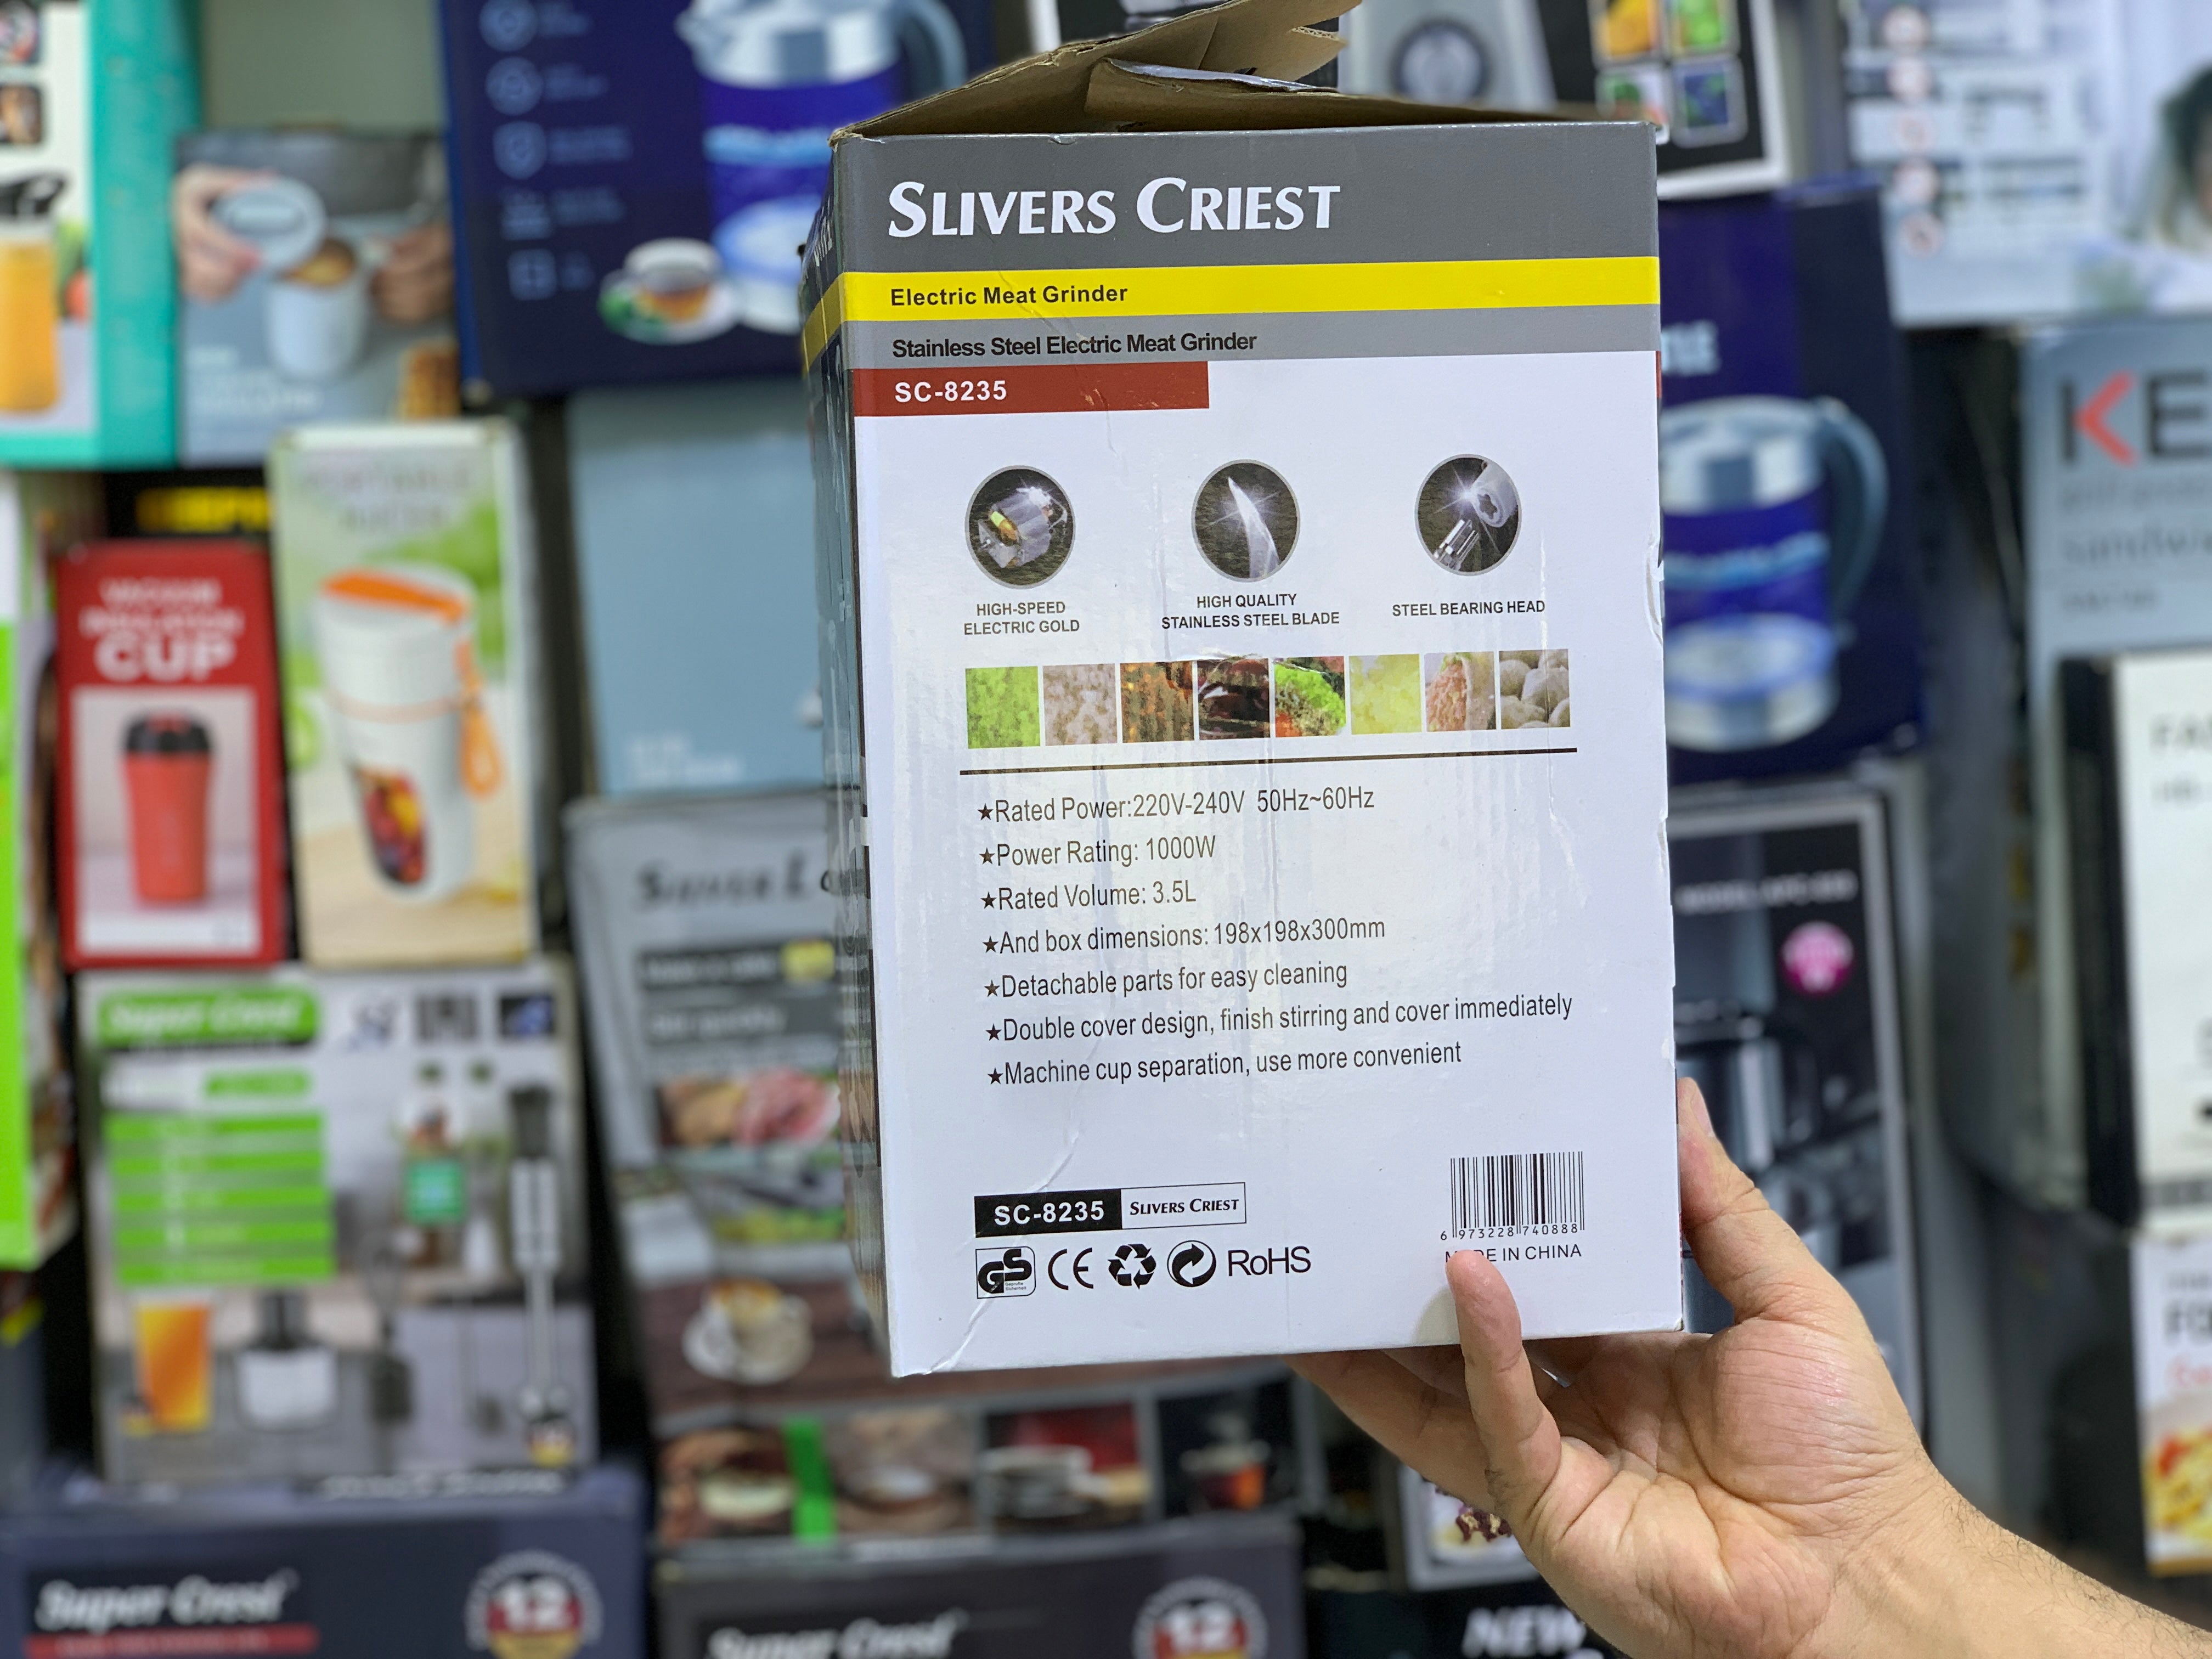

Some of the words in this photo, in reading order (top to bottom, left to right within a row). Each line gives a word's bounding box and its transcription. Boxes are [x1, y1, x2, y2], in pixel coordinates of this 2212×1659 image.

[888, 181, 1116, 238] SLIVERS
[1137, 177, 1340, 233] CRIEST
[890, 287, 977, 306] Electric
[984, 286, 1036, 304] Meat
[1043, 285, 1127, 303] Grinder
[893, 338, 985, 358] Stainless
[991, 337, 1041, 356] Steel
[1047, 335, 1121, 354] Electric
[1127, 334, 1176, 352] Meat
[1181, 332, 1257, 351] Grinder
[895, 380, 1007, 403] SC-8235
[977, 602, 1065, 616] HIGH-SPEED
[1197, 595, 1232, 609] HIGH
[1235, 594, 1297, 607] QUALITY
[1392, 603, 1437, 617] STEEL
[1440, 601, 1503, 616] BEARING
[1507, 600, 1545, 613] HEAD
[964, 621, 1035, 635] ELECTRIC
[1040, 620, 1080, 633] GOLD
[1161, 614, 1240, 629] STAINLESS
[1244, 613, 1289, 627] STEEL
[1293, 612, 1340, 625] BLADE
[95, 638, 235, 681] CUP
[995, 798, 1055, 822] Rated
[1257, 786, 1374, 812] 50Hz~60Hz
[997, 843, 1060, 866] Power
[1067, 839, 1138, 867] Rating:
[1146, 835, 1216, 861] 1000W
[999, 886, 1058, 910] Rated
[1065, 883, 1146, 907] Volume:
[1153, 880, 1196, 904] 3.5L
[1000, 930, 1039, 954] And
[1046, 929, 1081, 952] box
[1087, 923, 1208, 950] dimensions:
[1214, 917, 1385, 945] 198x198x300mm
[1002, 970, 1116, 997] Detachable
[1124, 969, 1173, 997] parts
[1178, 967, 1205, 990] for
[1211, 968, 1258, 992] easy
[1264, 961, 1347, 988] cleaning
[1004, 1015, 1075, 1041] Double
[1081, 1018, 1136, 1037] cover
[1142, 1010, 1215, 1038] design,
[1220, 1007, 1273, 1031] finish
[1279, 1005, 1347, 1031] stirring
[1353, 1001, 1389, 1024] and
[1396, 1001, 1449, 1023] cover
[1455, 992, 1573, 1020] immediately
[1006, 1059, 1090, 1085] Machine
[1096, 1061, 1132, 1085] cup
[1137, 1052, 1250, 1080] separation,
[1256, 1052, 1291, 1073] use
[1298, 1051, 1347, 1070] more
[1353, 1041, 1462, 1067] convenient
[994, 1200, 1104, 1226] SC-8235
[1228, 1246, 1311, 1277] RoHS
[1503, 1248, 1519, 1261] IN
[1525, 1244, 1582, 1260] CHINA
[36, 1580, 170, 1630] Super
[168, 1570, 288, 1625] Crest
